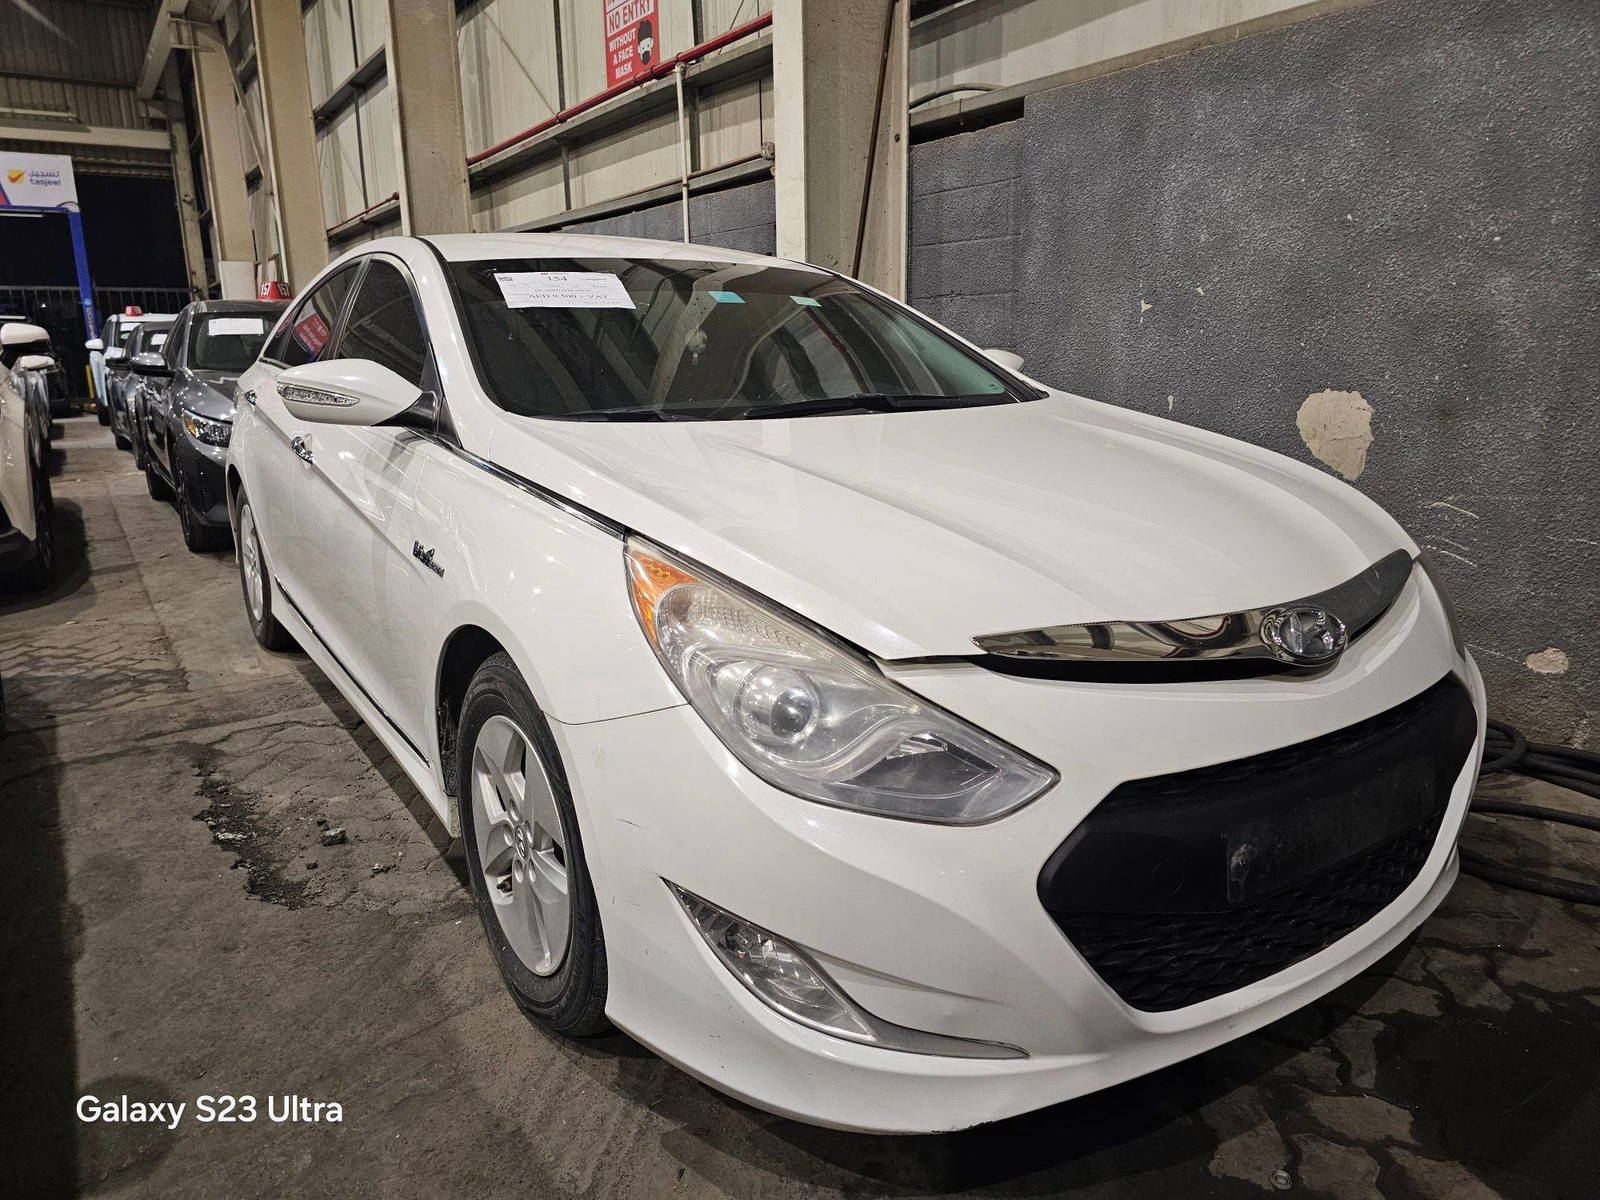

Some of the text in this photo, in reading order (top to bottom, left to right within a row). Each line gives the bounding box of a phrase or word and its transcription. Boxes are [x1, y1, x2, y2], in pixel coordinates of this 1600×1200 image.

[609, 0, 650, 33] NO ENTRY
[608, 28, 637, 53] WITHOUT
[613, 45, 634, 66] A FACE
[615, 61, 633, 80] MASK
[30, 178, 61, 187] tasjeel
